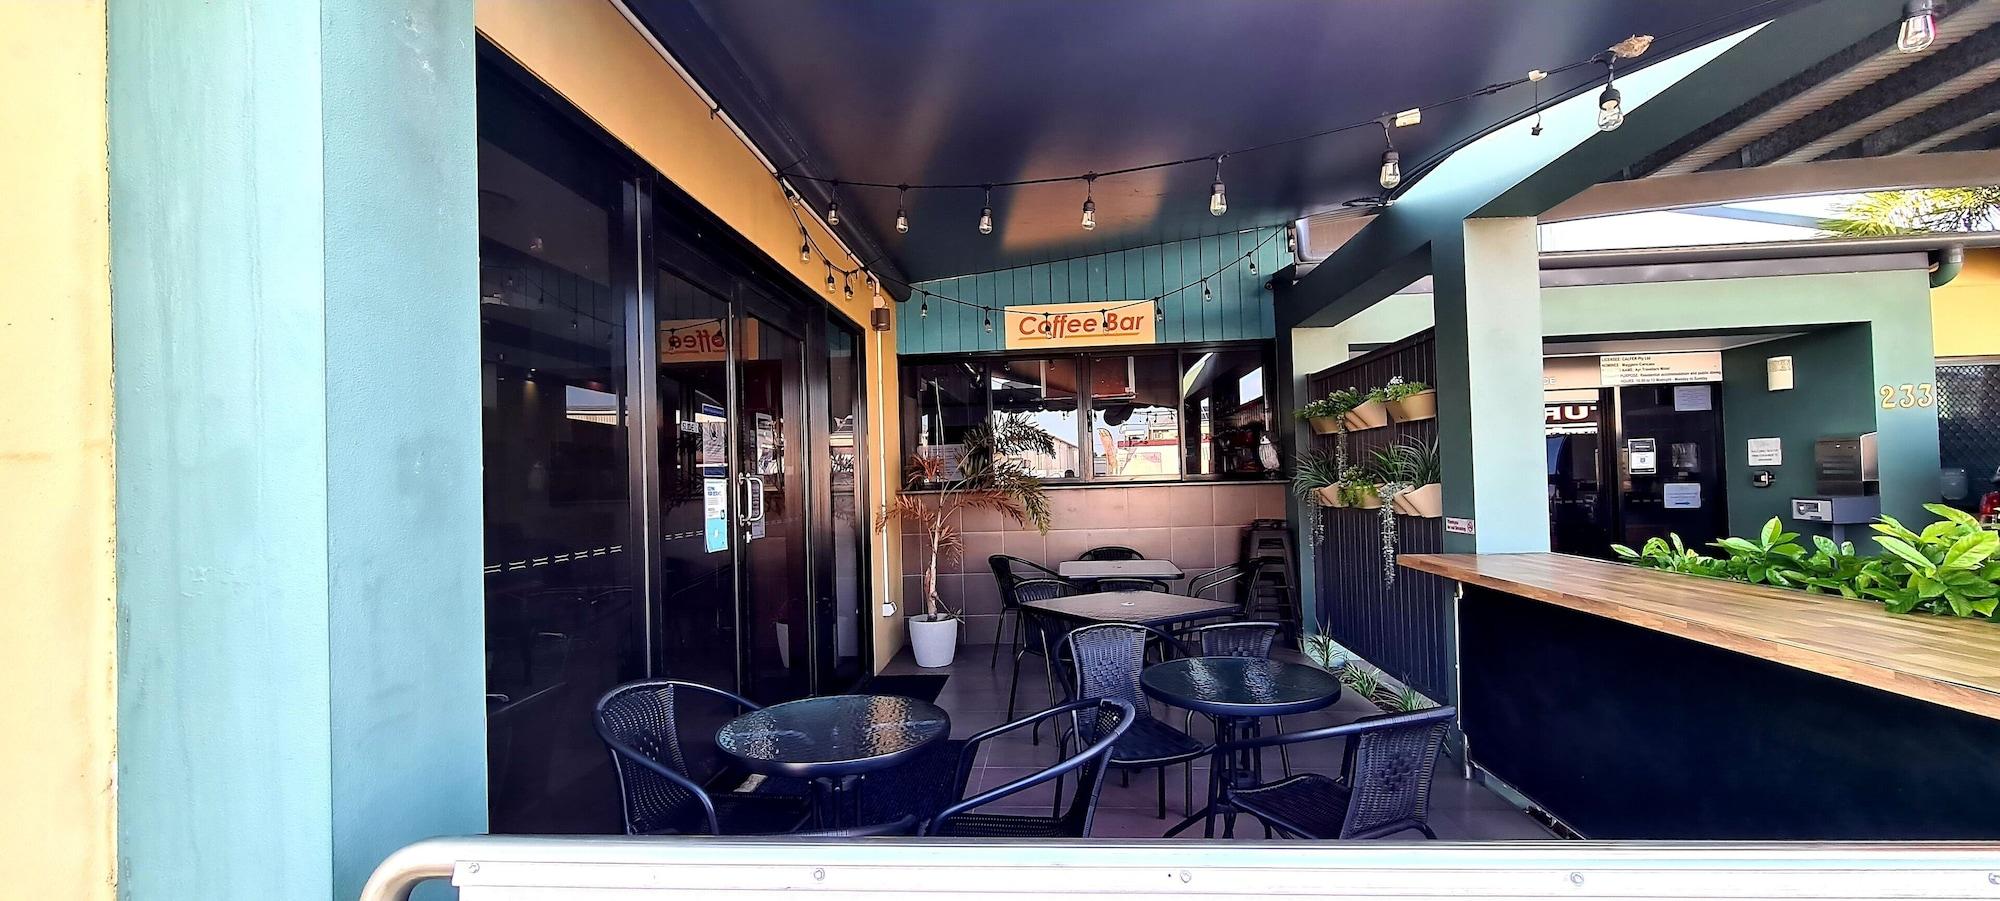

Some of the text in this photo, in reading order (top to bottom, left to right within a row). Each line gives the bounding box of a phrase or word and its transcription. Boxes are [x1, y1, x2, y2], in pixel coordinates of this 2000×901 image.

[1018, 313, 1145, 339] Coffee Bar
[1879, 383, 1934, 409] 233
